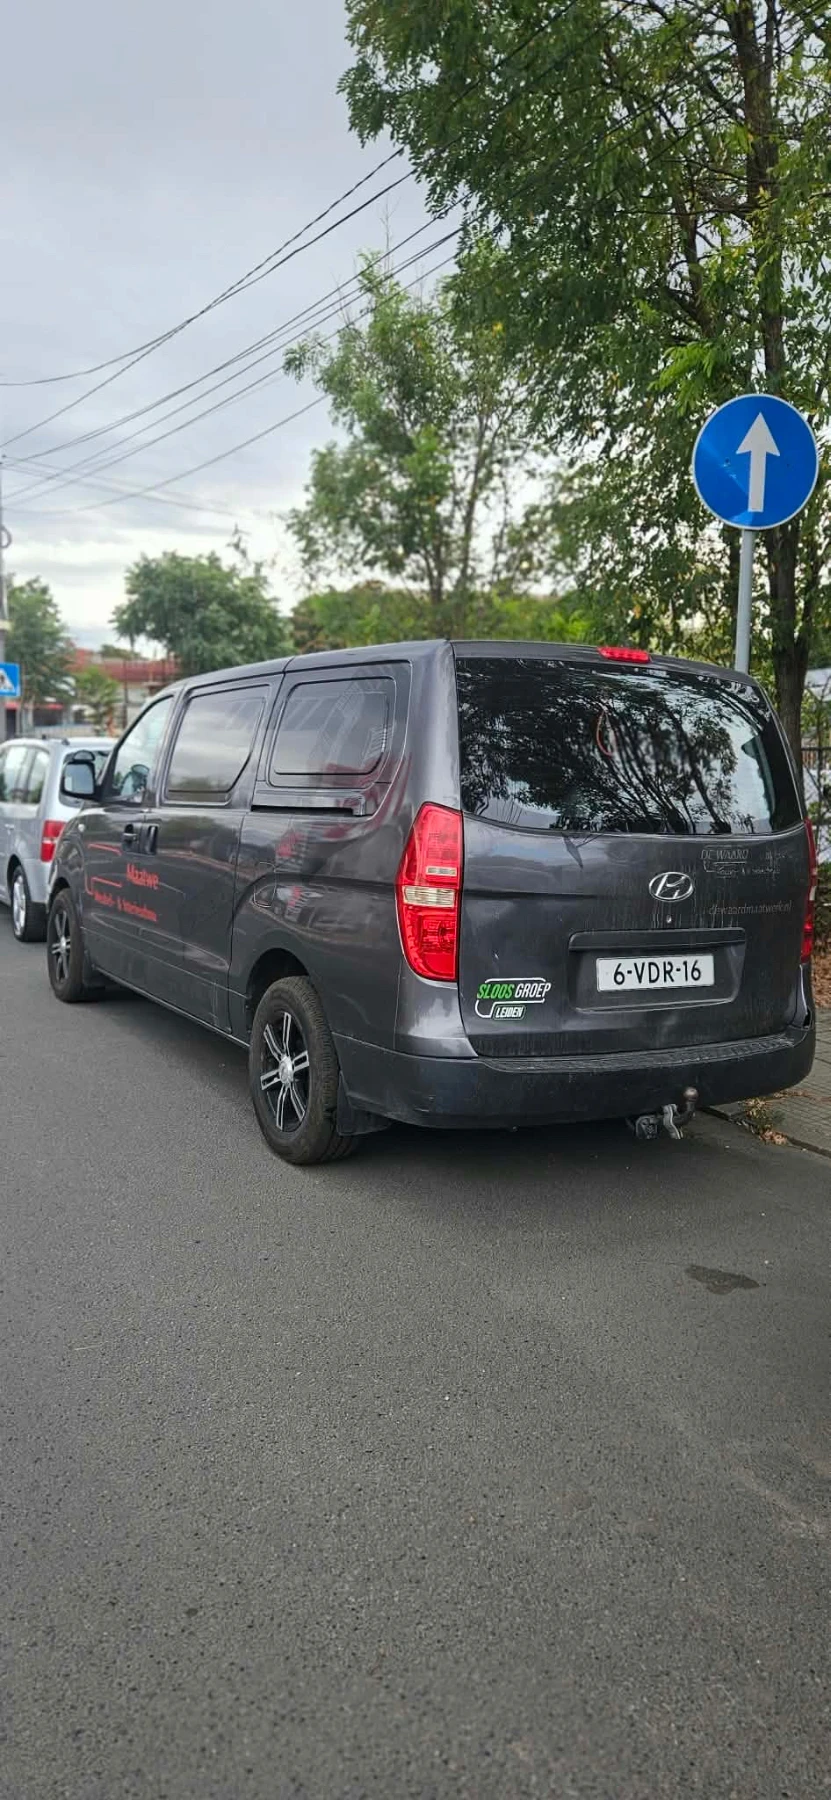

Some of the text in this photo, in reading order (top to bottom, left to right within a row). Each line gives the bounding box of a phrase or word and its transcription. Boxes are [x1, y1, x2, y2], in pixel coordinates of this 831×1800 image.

[613, 960, 702, 986] 6-VDR-16
[477, 982, 552, 999] SLOOS GROEP
[495, 1006, 524, 1018] LEIDEN
